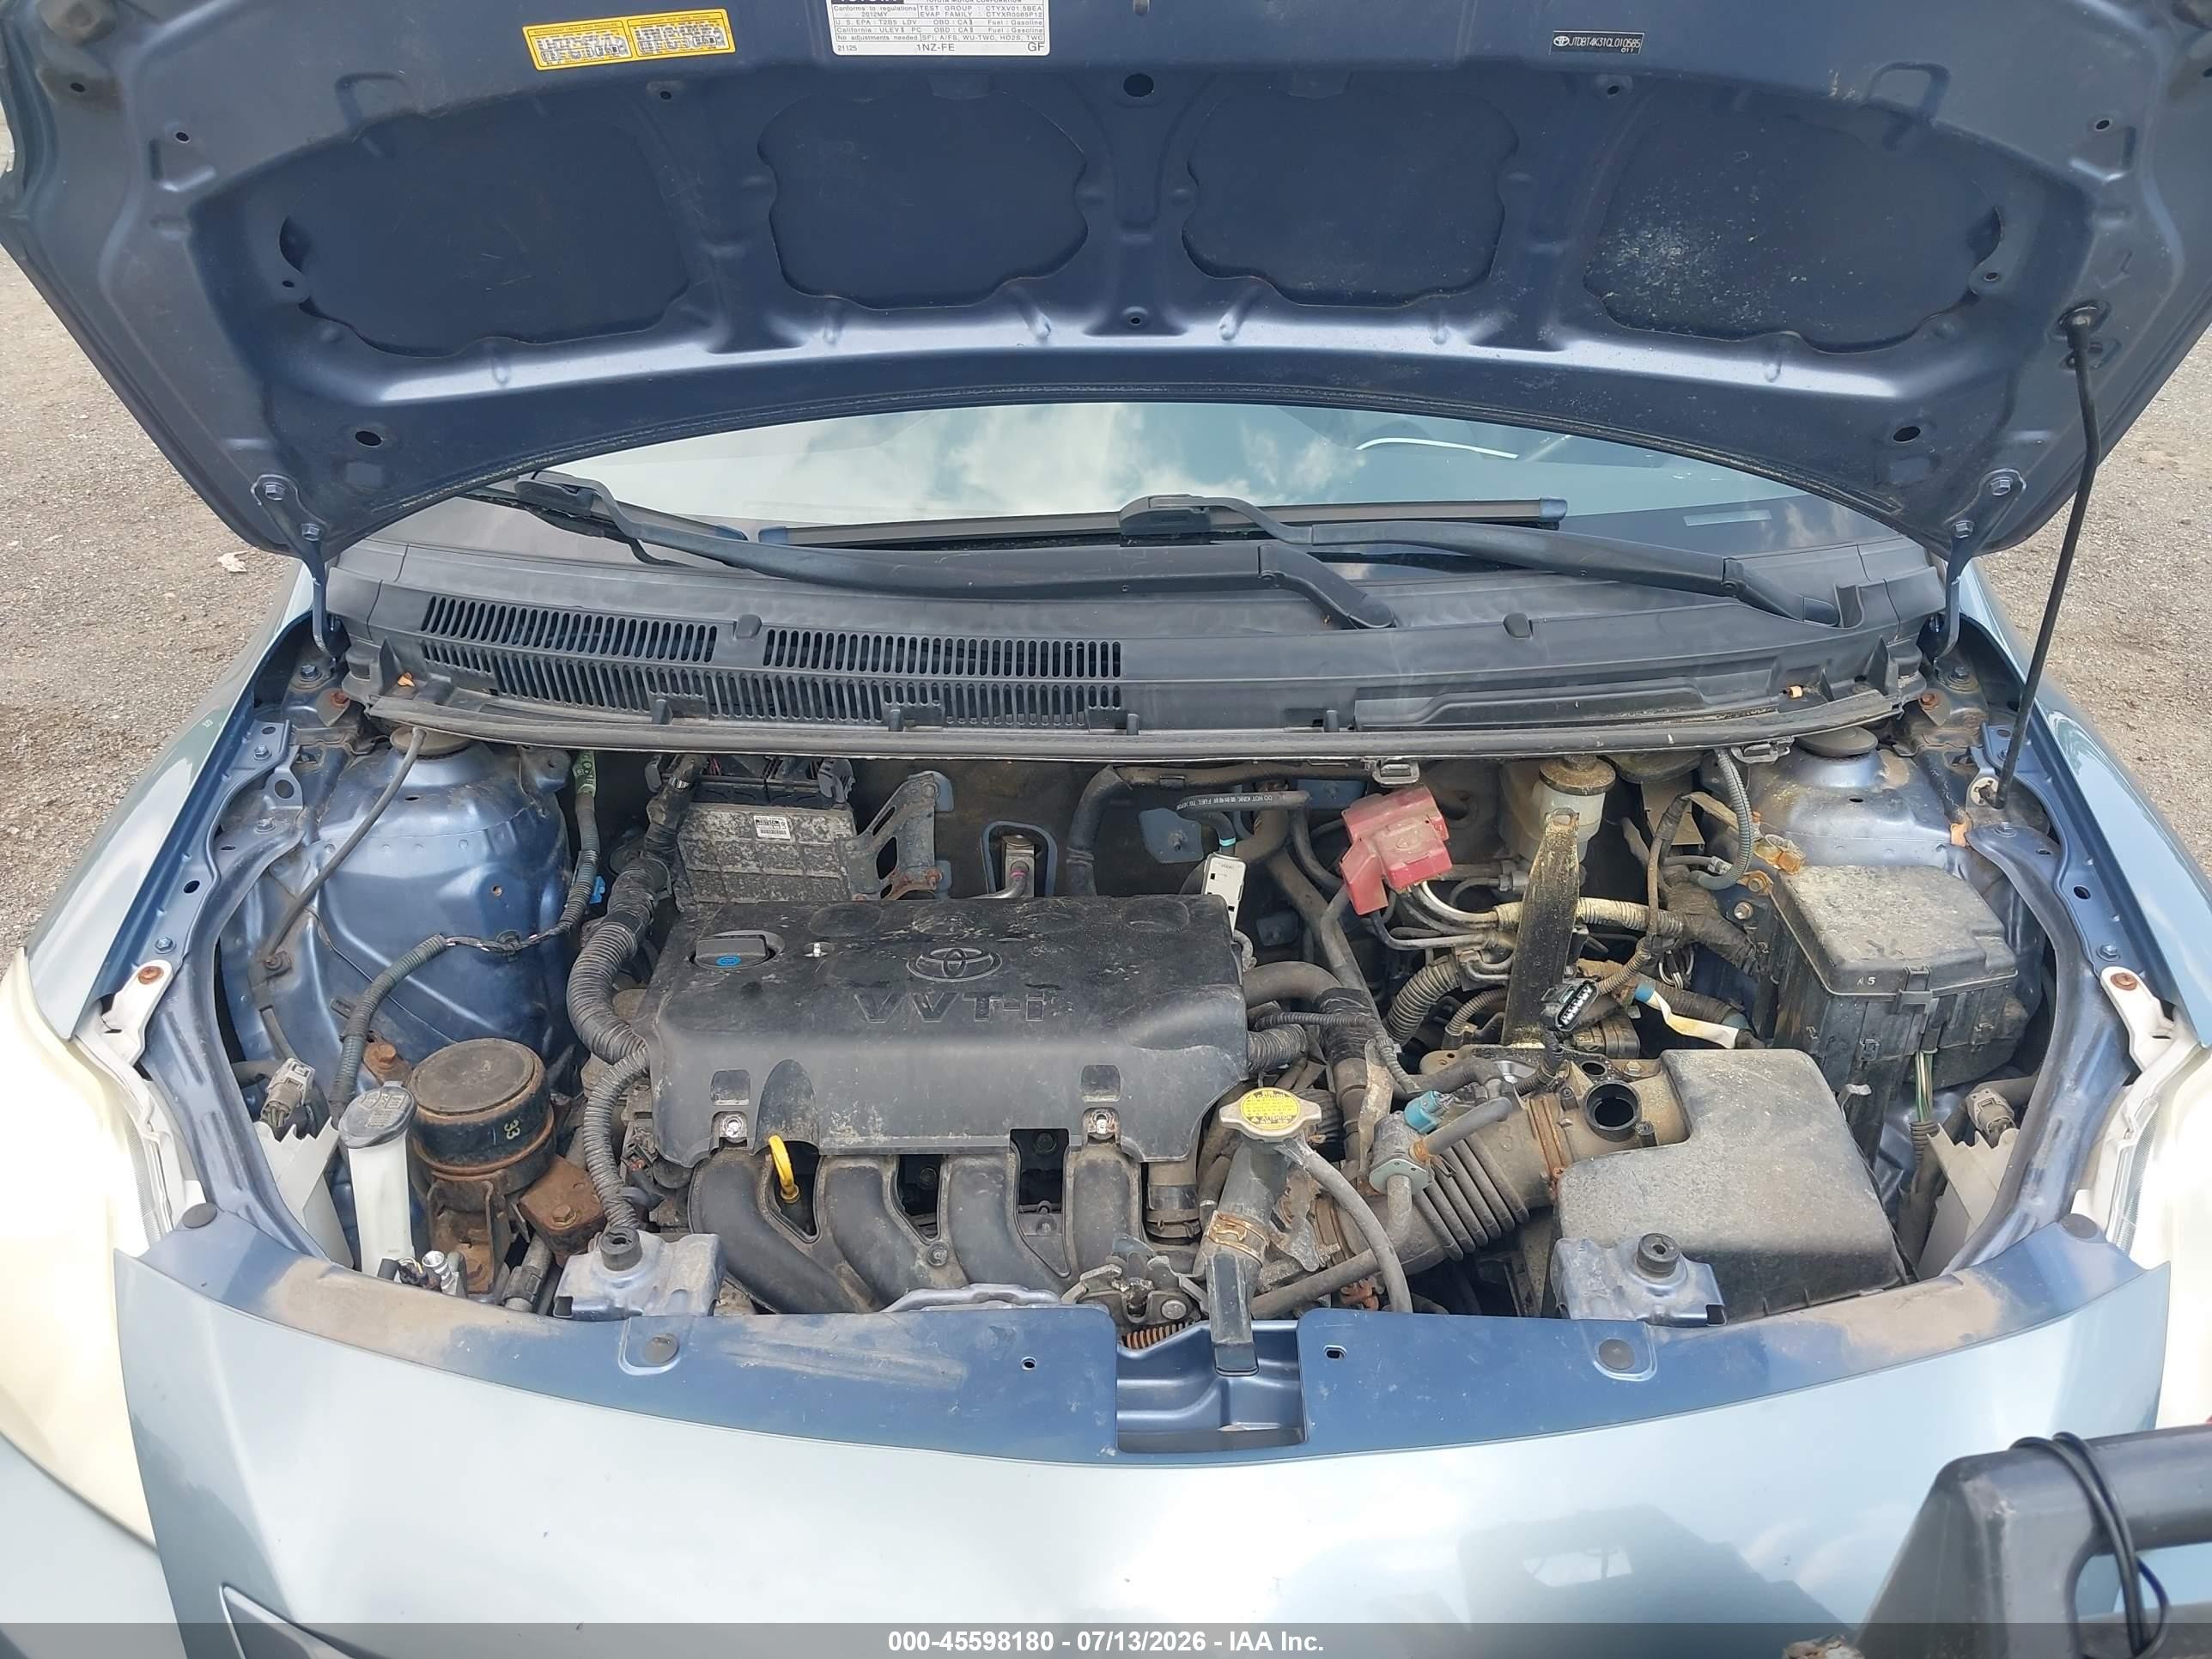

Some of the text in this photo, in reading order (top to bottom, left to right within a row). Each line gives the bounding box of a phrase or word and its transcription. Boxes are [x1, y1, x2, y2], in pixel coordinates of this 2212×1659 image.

[916, 43, 956, 52] 1NZ-FE
[1027, 42, 1045, 52] GF
[854, 991, 1045, 1024] VVT-i
